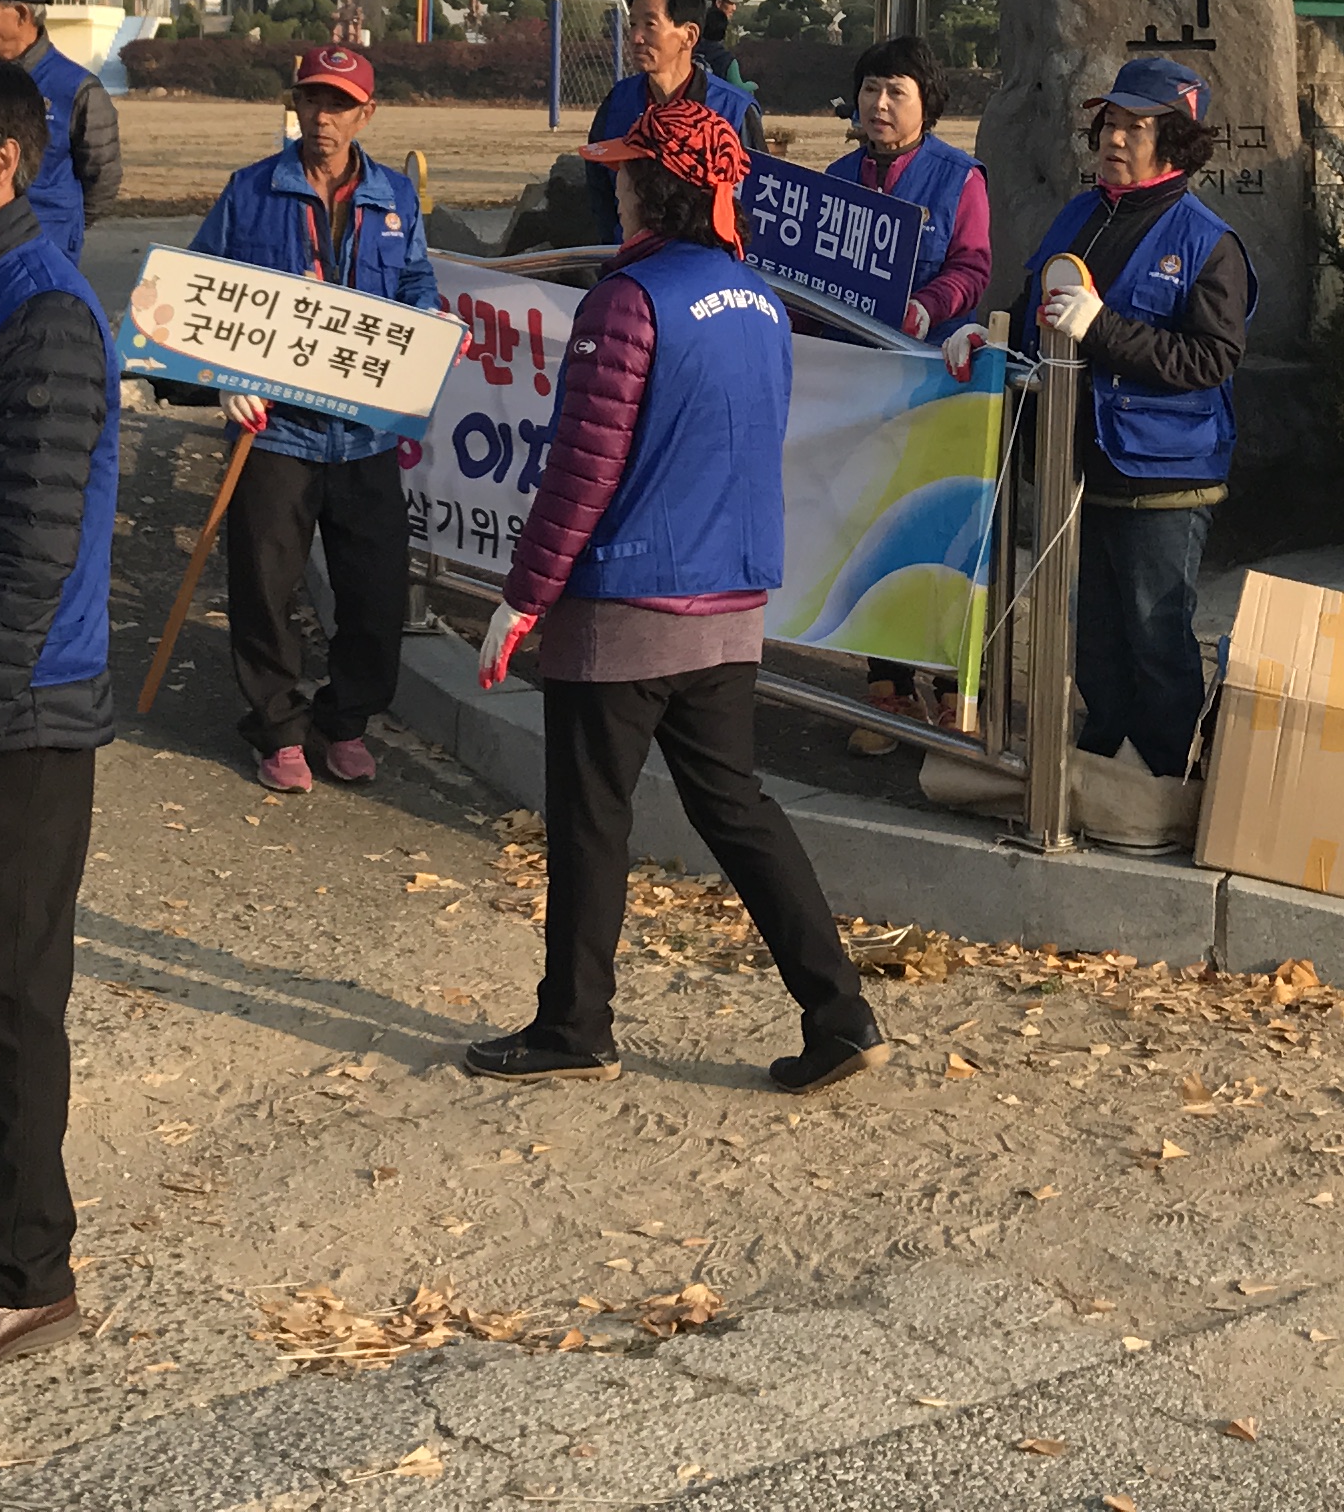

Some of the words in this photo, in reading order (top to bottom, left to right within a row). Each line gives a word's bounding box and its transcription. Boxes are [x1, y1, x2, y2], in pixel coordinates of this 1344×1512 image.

[752, 173, 809, 247] 추방
[814, 193, 901, 281] 캠페인
[181, 312, 278, 359] 굿바이
[286, 336, 319, 368] 성
[327, 347, 392, 388] 폭력
[183, 273, 281, 319] 굿바이
[293, 294, 416, 356] 학교폭력
